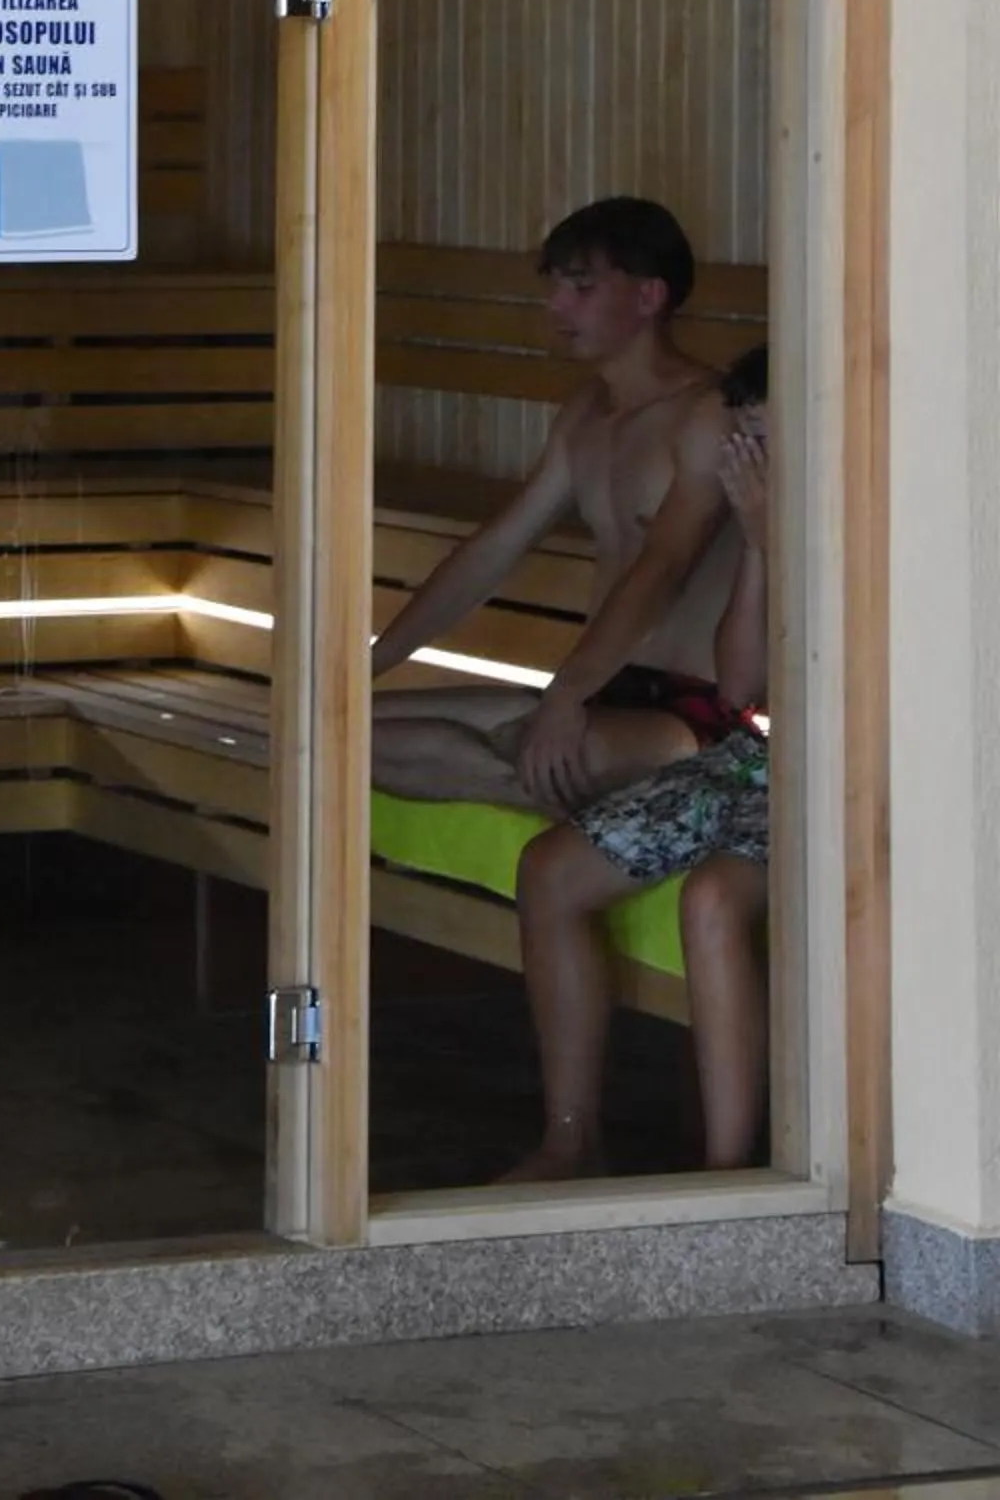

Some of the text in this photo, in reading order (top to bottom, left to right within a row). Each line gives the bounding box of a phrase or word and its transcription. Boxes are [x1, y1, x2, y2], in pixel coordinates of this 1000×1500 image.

[12, 51, 72, 75] SAUNĂ
[91, 83, 116, 97] SUB
[0, 103, 57, 118] PICIOARE
